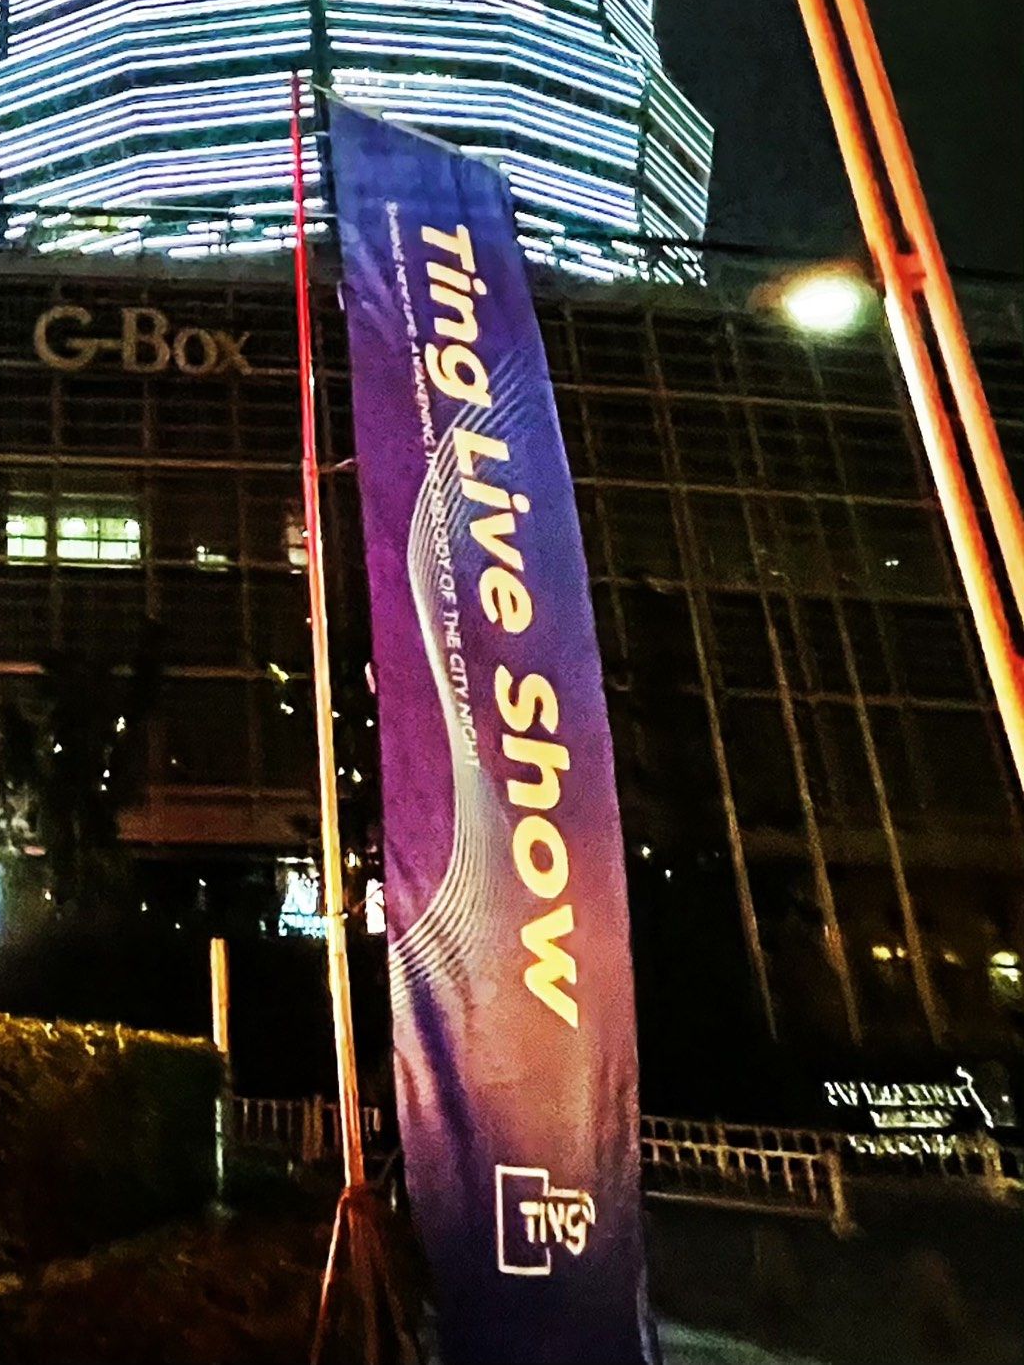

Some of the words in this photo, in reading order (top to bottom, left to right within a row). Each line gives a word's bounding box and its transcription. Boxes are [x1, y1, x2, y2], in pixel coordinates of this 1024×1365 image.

[420, 223, 494, 409] Ting
[452, 427, 533, 634] Live
[443, 609, 462, 650] THE
[449, 652, 472, 700] CITY
